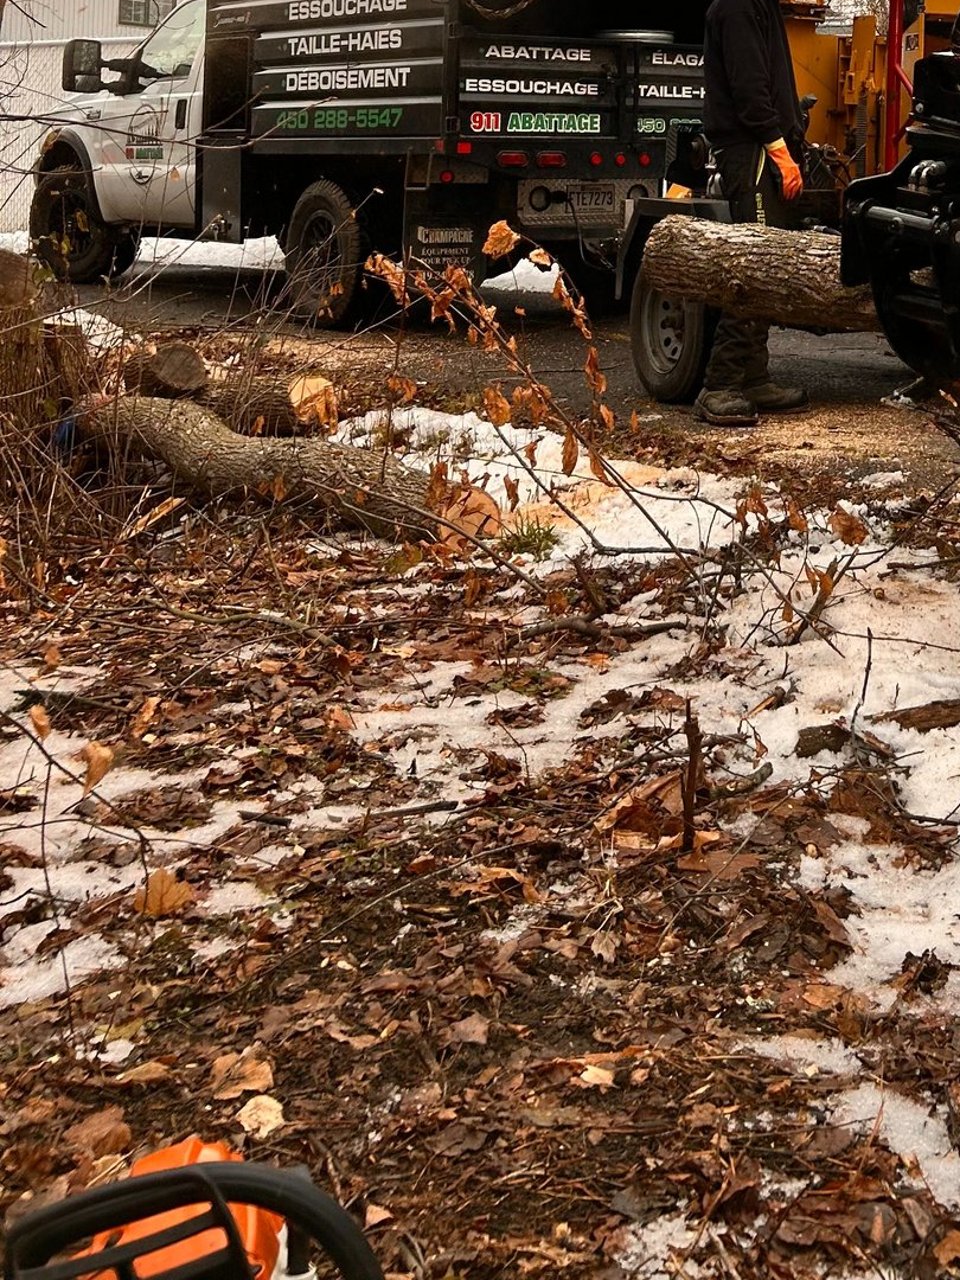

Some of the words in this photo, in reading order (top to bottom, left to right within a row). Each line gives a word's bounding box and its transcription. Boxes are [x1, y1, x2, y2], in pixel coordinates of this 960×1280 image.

[288, 29, 402, 56] TAILLE-HAIES
[485, 45, 591, 62] ABATTAGE
[465, 78, 599, 96] ESSOUCHAGE
[277, 110, 309, 129] 450
[314, 108, 403, 129] 288-5547
[470, 111, 501, 133] 911
[507, 112, 601, 134] ABATTAGE
[419, 227, 475, 244] CHAMPAGNE
